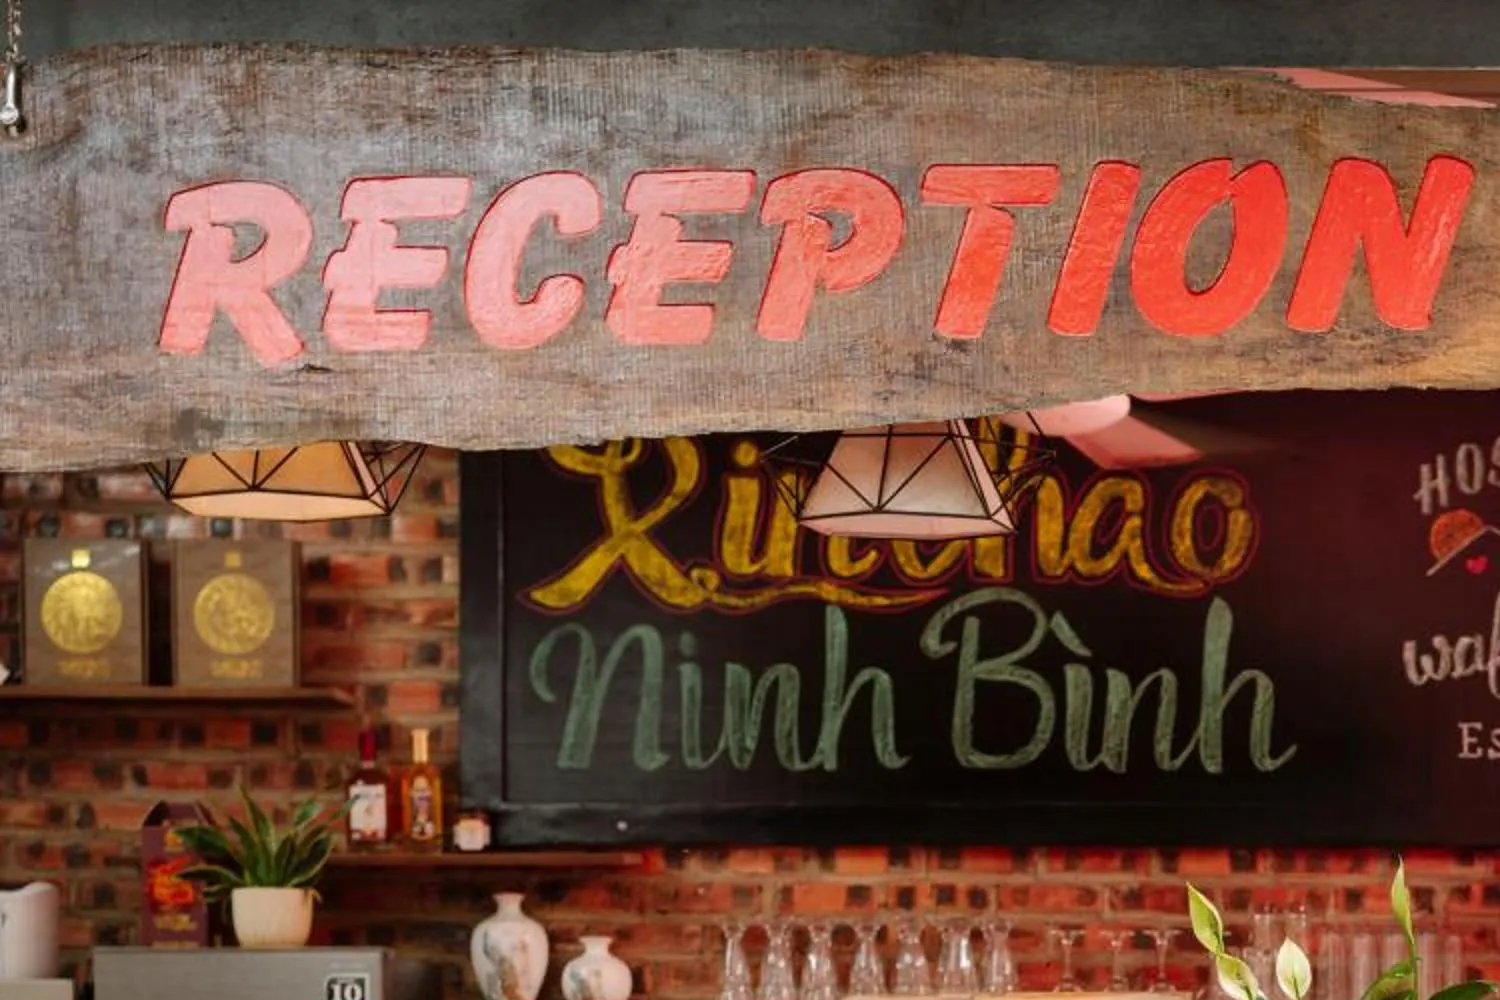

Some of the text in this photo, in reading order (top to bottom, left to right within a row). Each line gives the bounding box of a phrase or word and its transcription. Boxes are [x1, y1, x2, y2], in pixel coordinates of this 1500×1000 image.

[158, 152, 1478, 368] RECEPTION
[529, 586, 1297, 776] Ninh Bình
